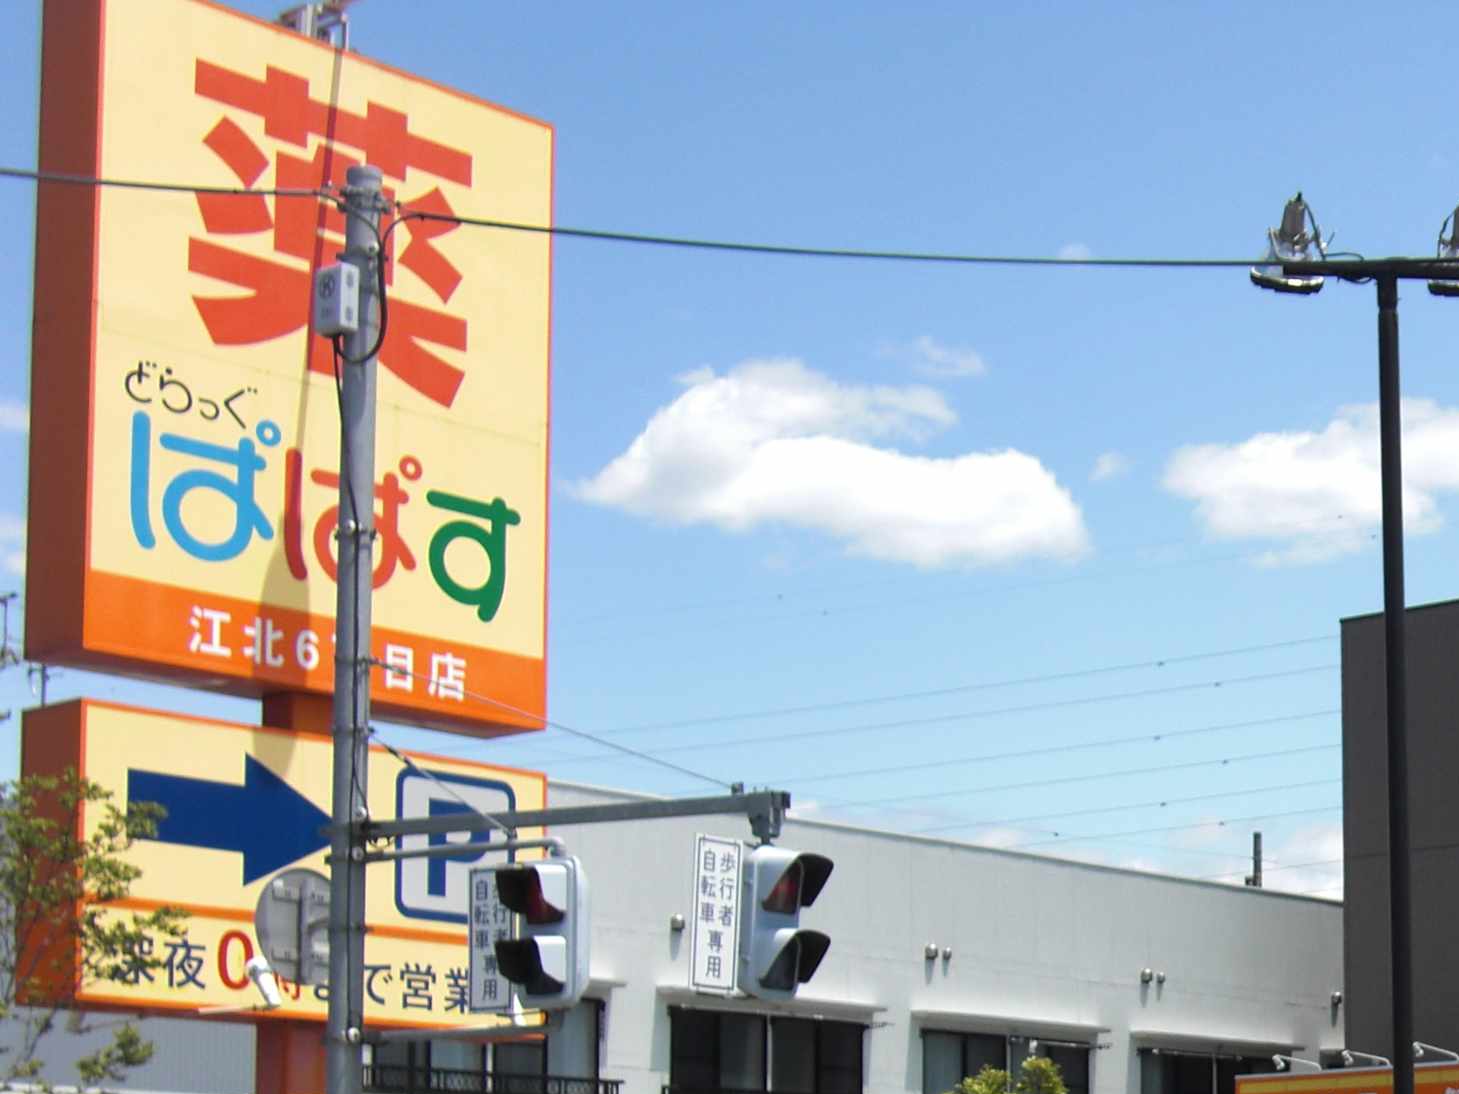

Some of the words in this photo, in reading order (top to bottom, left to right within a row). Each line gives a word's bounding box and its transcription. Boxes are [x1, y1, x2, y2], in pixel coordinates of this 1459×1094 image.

[187, 58, 473, 410] 薬
[124, 361, 258, 429] どらっぐ
[188, 605, 468, 701] 江北6目店
[427, 798, 491, 897] P
[700, 849, 716, 924] 自転車
[705, 930, 724, 979] 専用
